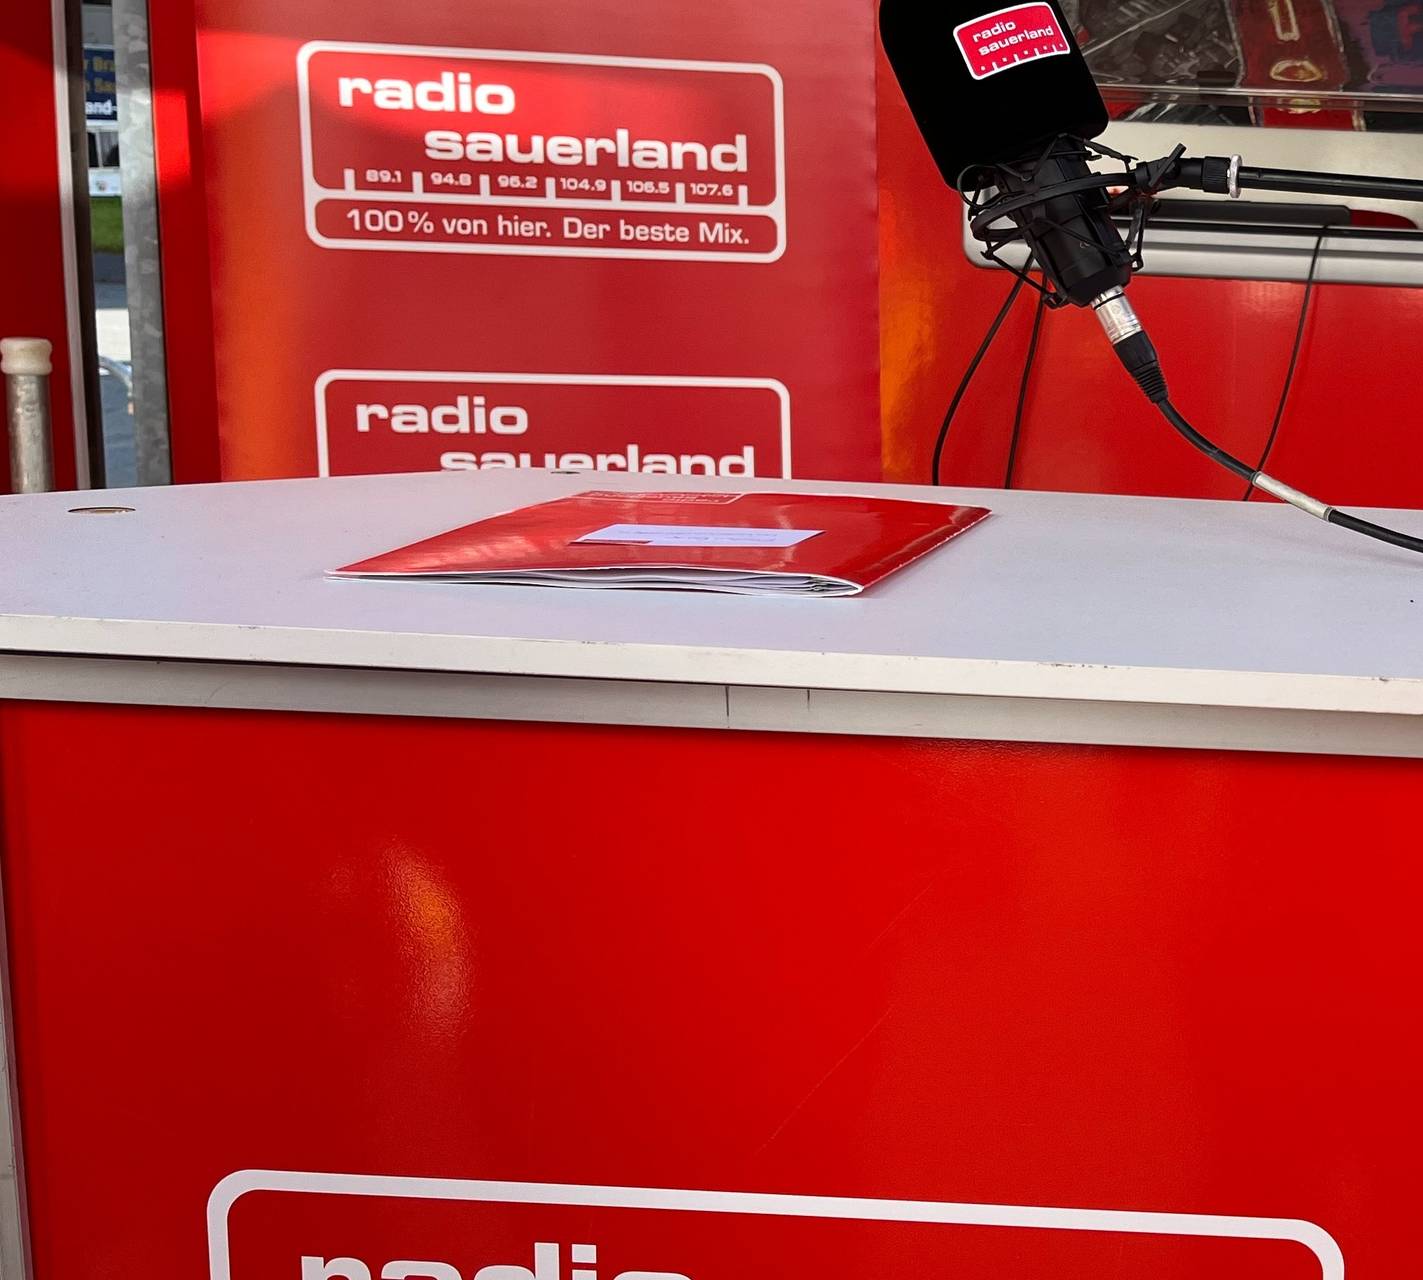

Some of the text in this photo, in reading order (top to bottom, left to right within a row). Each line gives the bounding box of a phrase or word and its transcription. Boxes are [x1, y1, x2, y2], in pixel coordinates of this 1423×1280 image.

[972, 21, 1016, 42] radio
[977, 25, 1055, 56] sauerland
[338, 71, 516, 115] radio
[424, 128, 748, 173] sauerland
[365, 169, 402, 183] 89.1
[430, 172, 472, 186] 94.8
[560, 177, 607, 192] 104.9
[690, 183, 734, 197] 107.6
[441, 217, 488, 236] von
[497, 214, 552, 238] hier.
[563, 216, 610, 240] Der
[619, 219, 690, 243] beste
[699, 222, 750, 245] Mix.
[356, 395, 529, 435] radio
